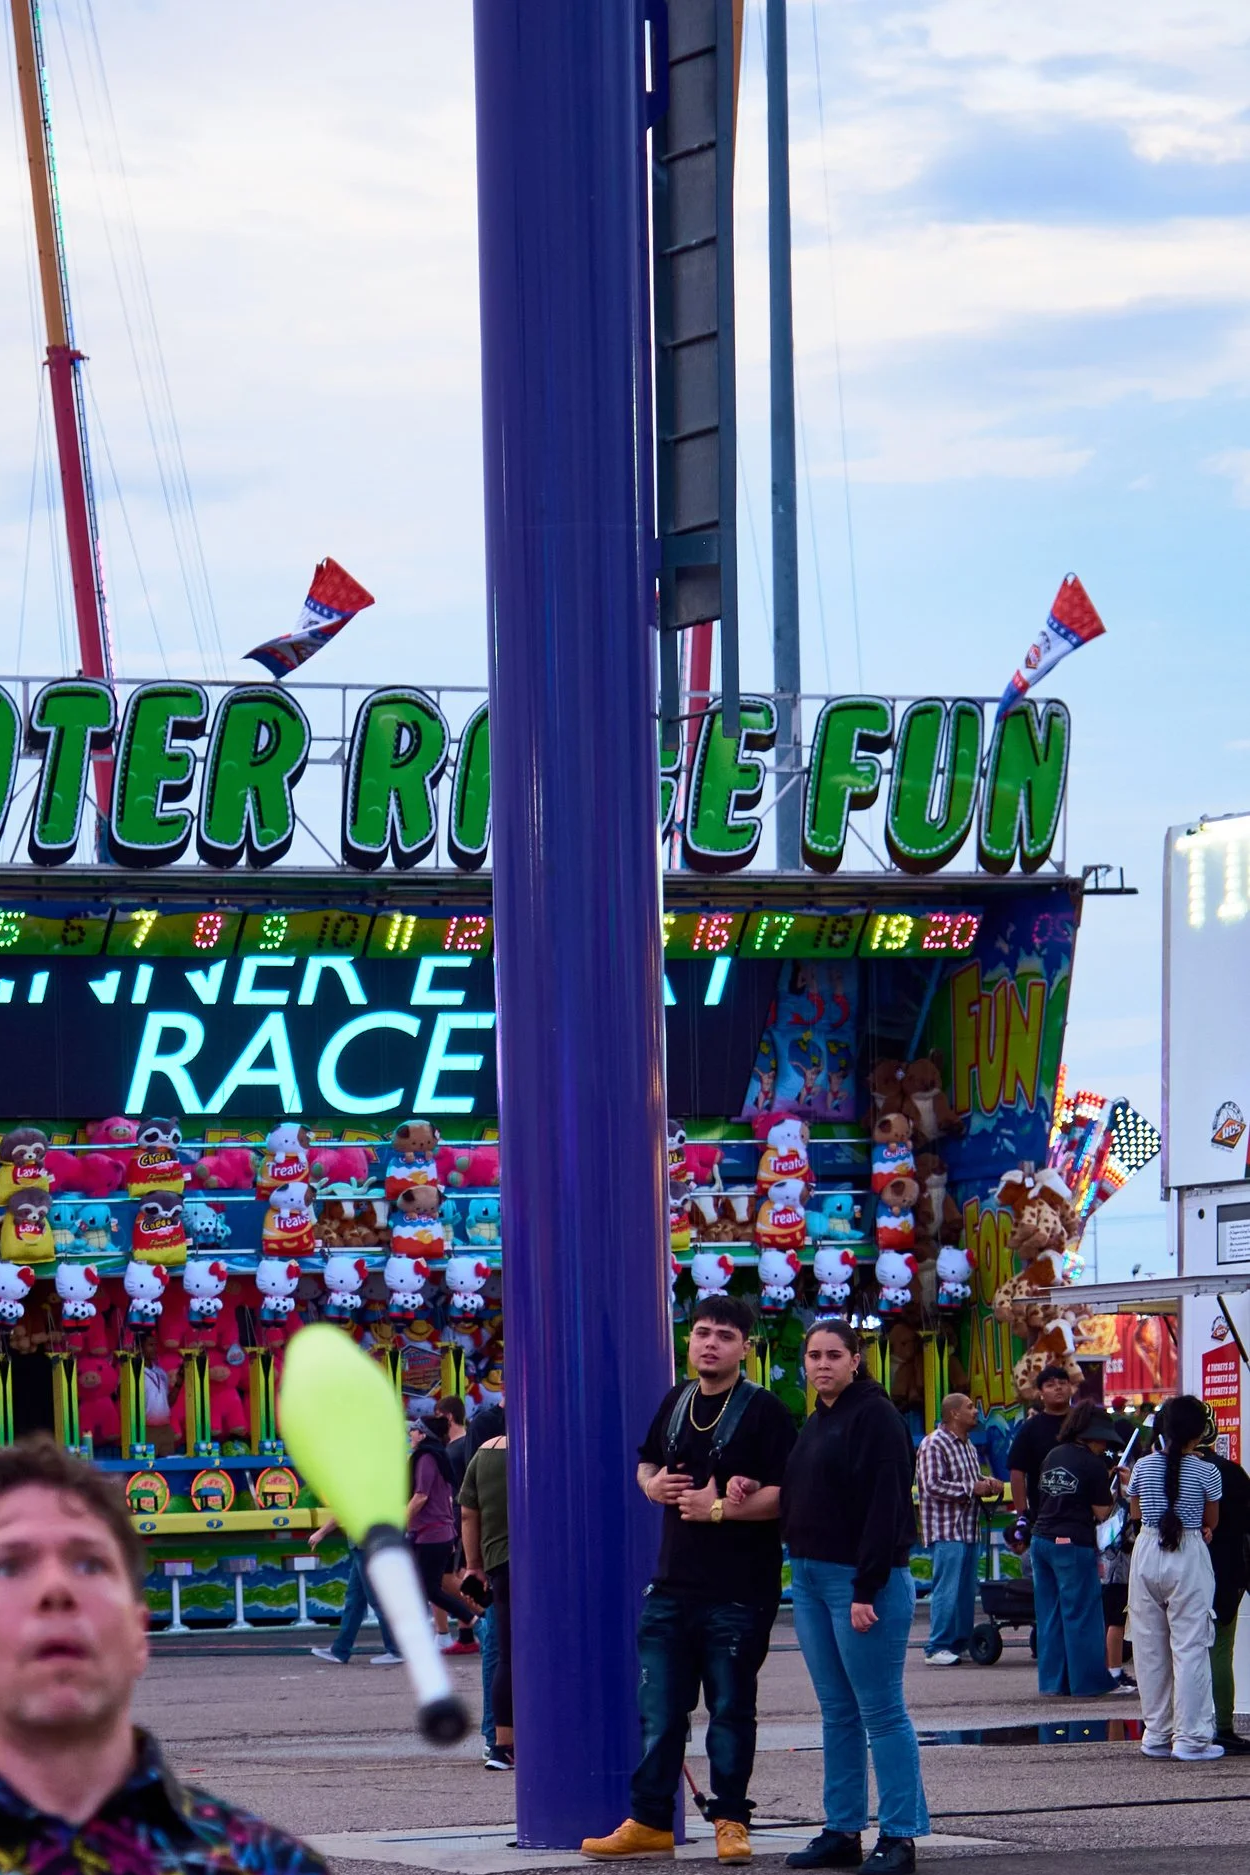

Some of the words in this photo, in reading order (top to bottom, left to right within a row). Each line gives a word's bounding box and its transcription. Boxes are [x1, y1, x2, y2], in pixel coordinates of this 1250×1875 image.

[343, 684, 777, 874] RE
[802, 695, 1071, 874] FUN
[61, 912, 87, 945] 6
[131, 912, 158, 949] 7
[195, 914, 223, 949] 8
[259, 914, 288, 950] 9
[317, 914, 359, 949] 10
[386, 914, 417, 951] 11
[444, 916, 487, 950] 12
[692, 917, 734, 951] 16
[754, 915, 796, 951] 17
[871, 914, 913, 950] 19
[923, 914, 979, 950] 20
[124, 1011, 497, 1114] RACE
[953, 960, 1048, 1117] FUN
[963, 1196, 1016, 1306] FOR
[967, 1302, 1023, 1420] ALL
